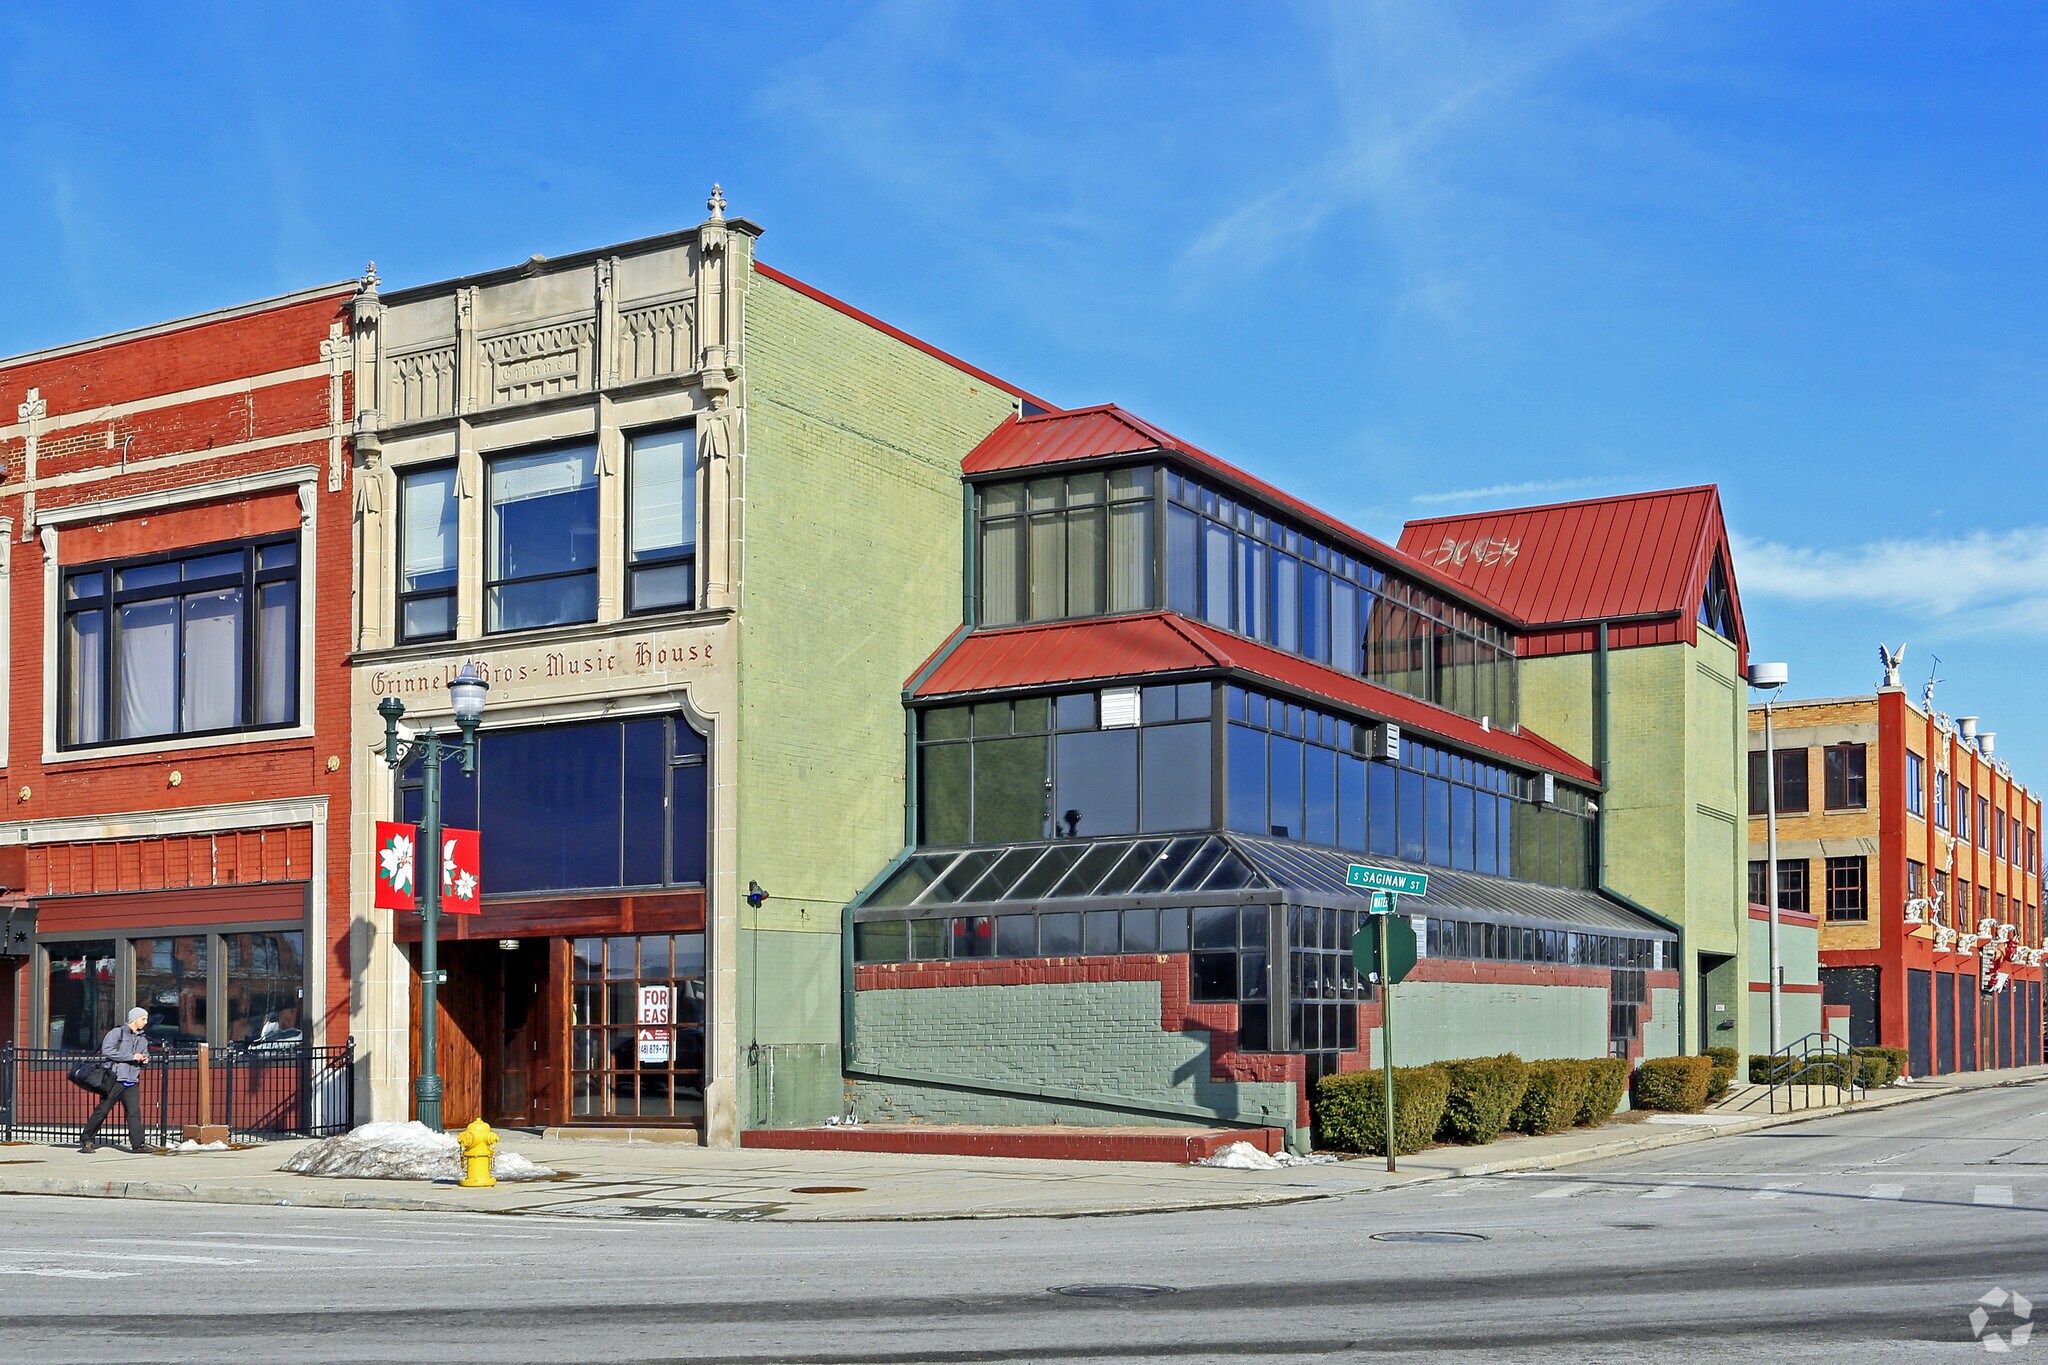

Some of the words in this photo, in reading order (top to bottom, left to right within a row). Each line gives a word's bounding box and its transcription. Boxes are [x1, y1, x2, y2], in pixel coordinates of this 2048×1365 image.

[546, 648, 616, 678] Music
[635, 641, 714, 668] House
[1353, 872, 1359, 881] S
[1362, 871, 1407, 888] SAGINAW
[1410, 880, 1420, 890] ST
[644, 990, 667, 1005] FOR
[639, 1009, 667, 1024] EAS
[649, 1044, 669, 1054] 879-77
